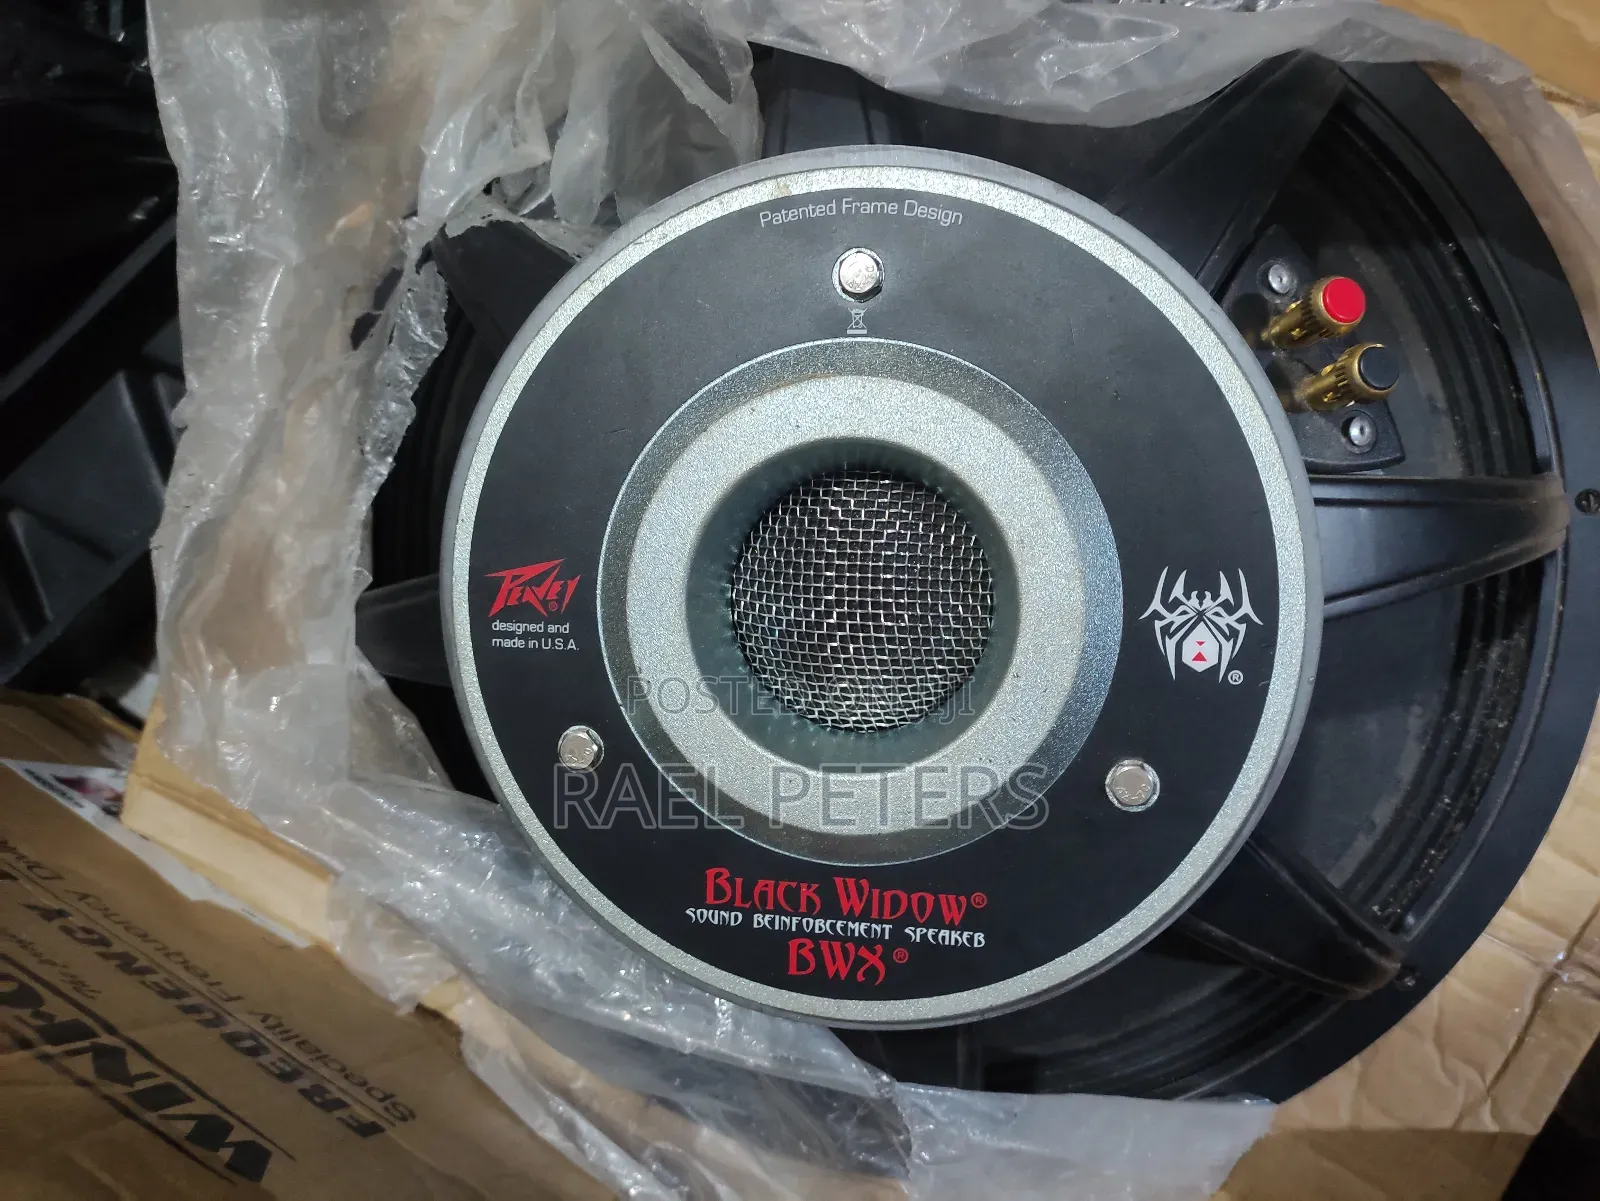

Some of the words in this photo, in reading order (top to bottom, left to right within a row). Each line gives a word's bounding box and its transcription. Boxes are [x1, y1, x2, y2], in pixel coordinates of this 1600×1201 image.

[759, 199, 836, 228] Patented
[841, 197, 899, 215] Frame
[903, 199, 963, 227] Design
[491, 619, 545, 635] designed
[547, 622, 570, 634] and
[491, 636, 526, 649] made
[528, 637, 539, 649] in
[541, 637, 580, 651] U.S.A.
[704, 867, 822, 916] BLACK
[684, 907, 743, 927] SOUND
[15, 901, 387, 1139] FREQUENCY
